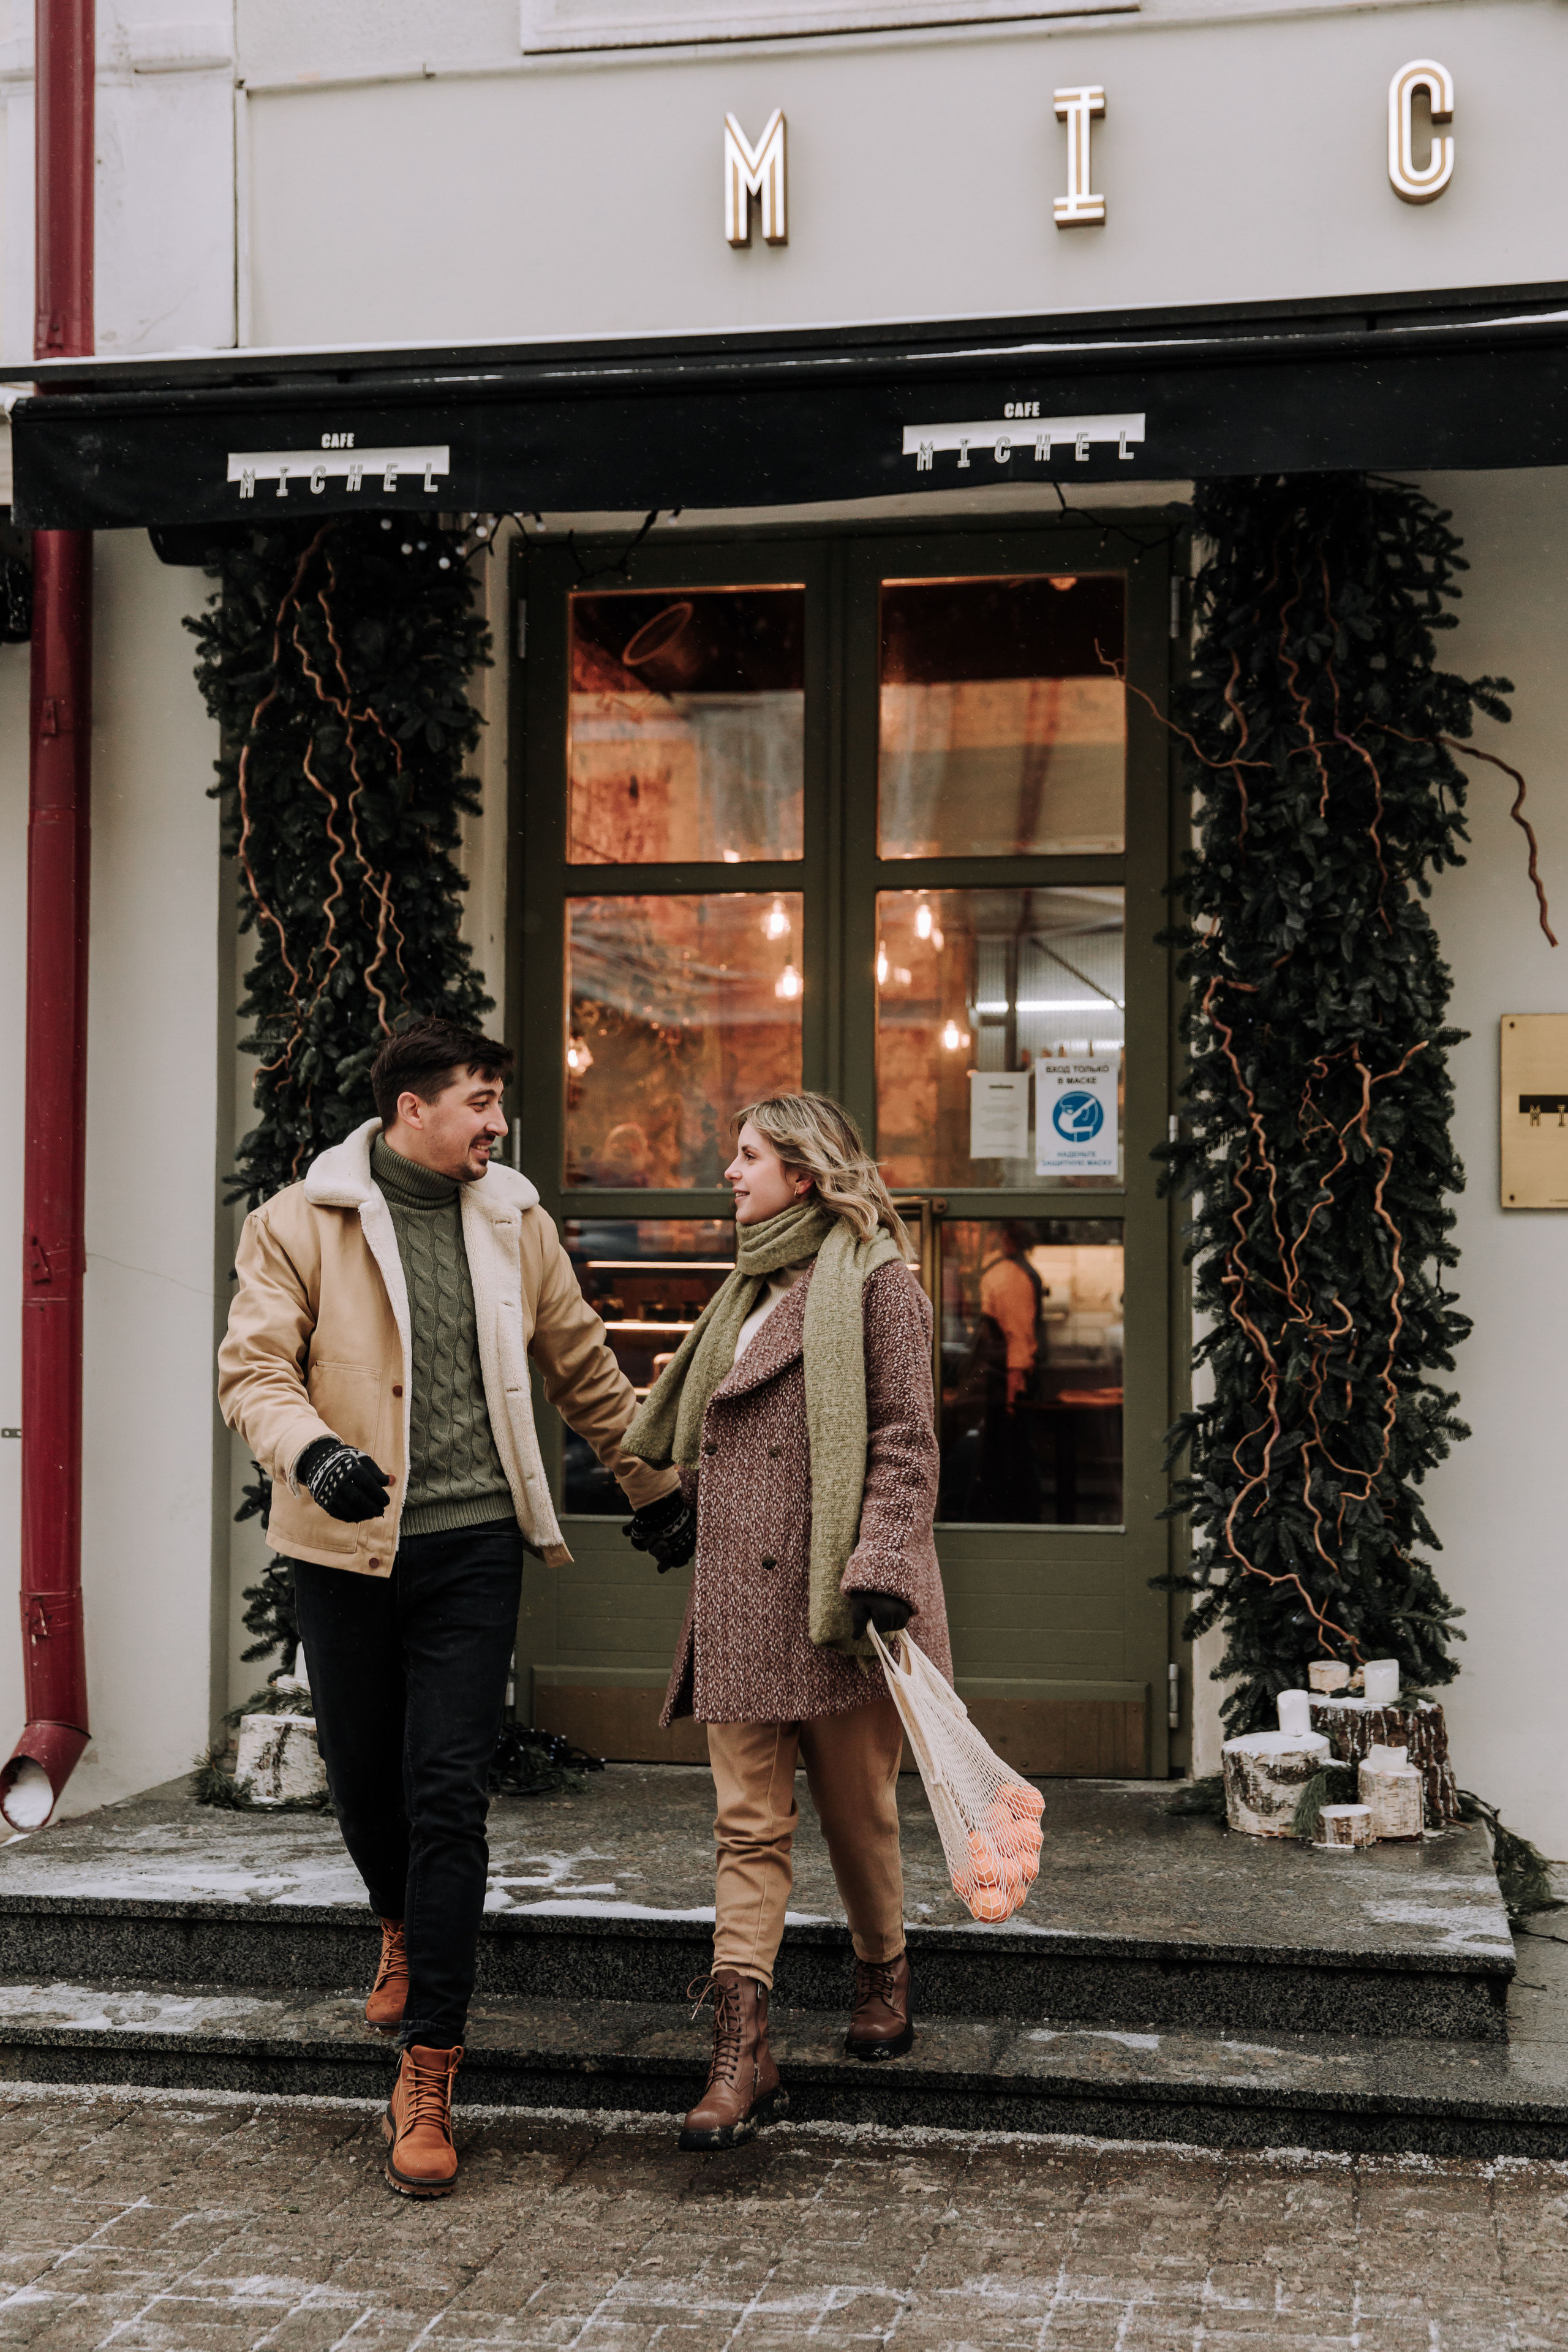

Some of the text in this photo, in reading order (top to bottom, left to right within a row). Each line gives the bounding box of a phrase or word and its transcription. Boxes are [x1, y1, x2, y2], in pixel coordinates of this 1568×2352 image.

[725, 58, 1455, 247] MIC
[1004, 401, 1041, 418] CAFE
[321, 432, 355, 449] CAFE
[916, 430, 1134, 471] MICHEL
[239, 462, 439, 499] MICHEL
